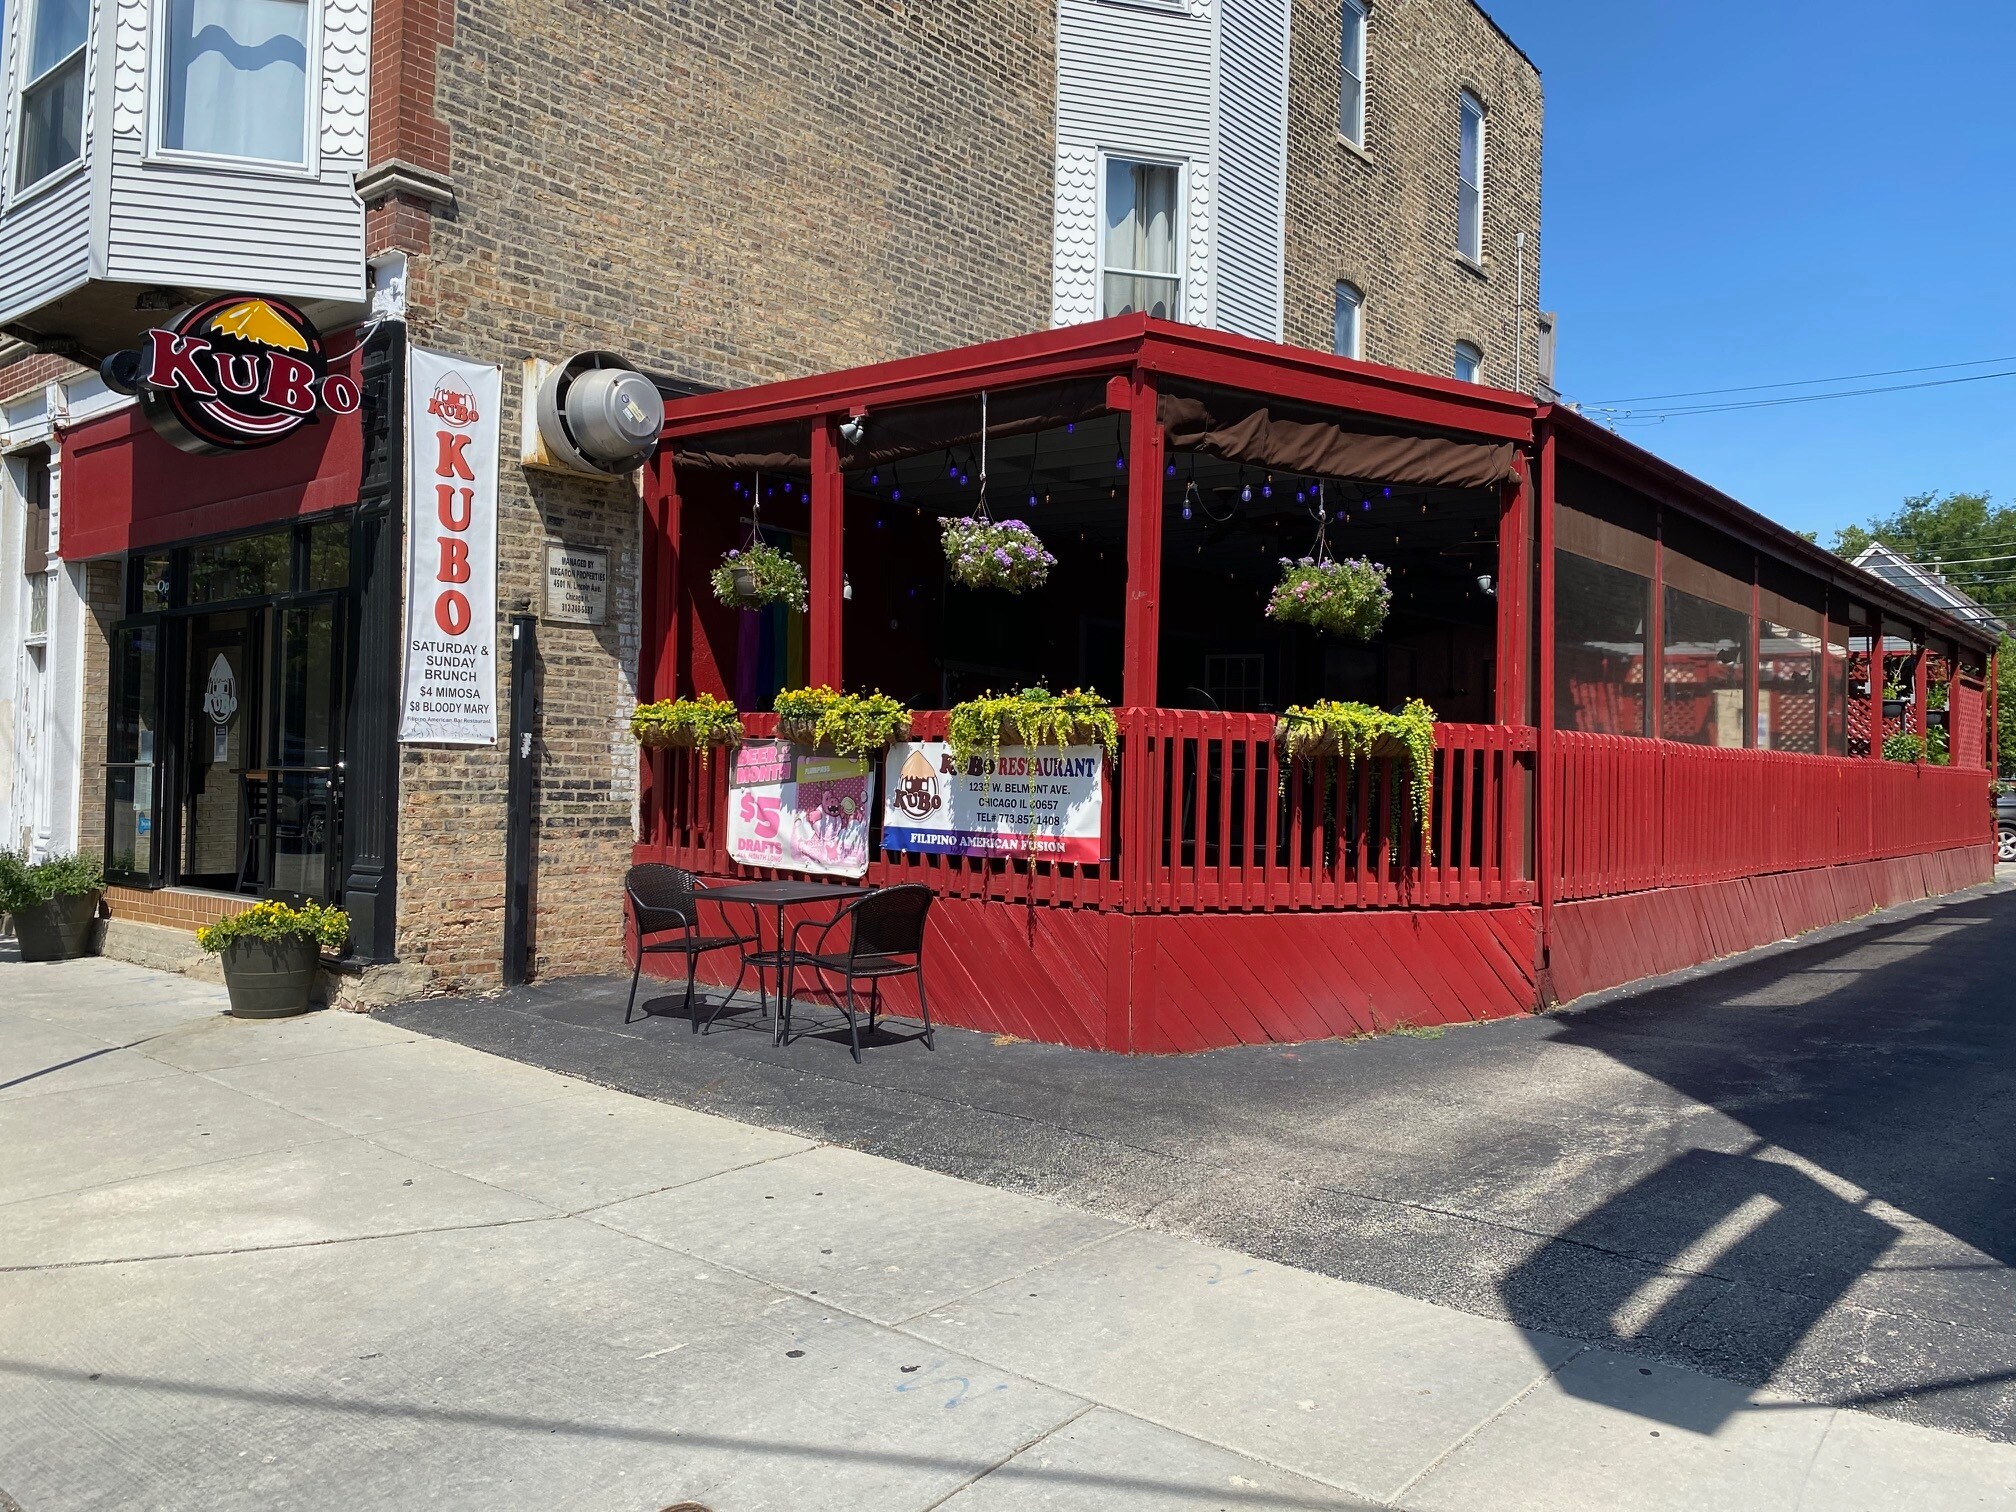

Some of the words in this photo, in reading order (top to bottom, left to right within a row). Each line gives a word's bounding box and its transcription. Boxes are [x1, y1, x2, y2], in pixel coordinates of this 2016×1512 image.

[434, 431, 475, 636] KUBO
[561, 557, 587, 568] MANAGED
[588, 560, 594, 569] BY
[413, 641, 477, 654] SATURDAY
[480, 645, 489, 656] &
[426, 655, 476, 668] SUNDAY
[424, 669, 477, 682] BRUNCH
[420, 685, 433, 697] $4
[435, 687, 481, 699] MIMOSA
[409, 701, 420, 712] $8
[422, 702, 462, 714] BLOODY
[463, 703, 490, 715] MARY
[737, 746, 778, 767] BEER
[939, 753, 996, 777] KBO
[998, 756, 1095, 778] RESTAURANT
[736, 762, 791, 784] MONTH
[992, 783, 1003, 793] W.
[1050, 784, 1071, 795] AVE.
[1019, 799, 1027, 809] IL
[740, 792, 781, 838] $5
[976, 813, 996, 823] TEL#
[998, 814, 1060, 826] 773.857.1408
[738, 838, 783, 855] DRAFTS
[910, 832, 957, 846] FILIPINO
[959, 836, 1018, 850] AMERICAN
[1020, 840, 1066, 853] FUSION
